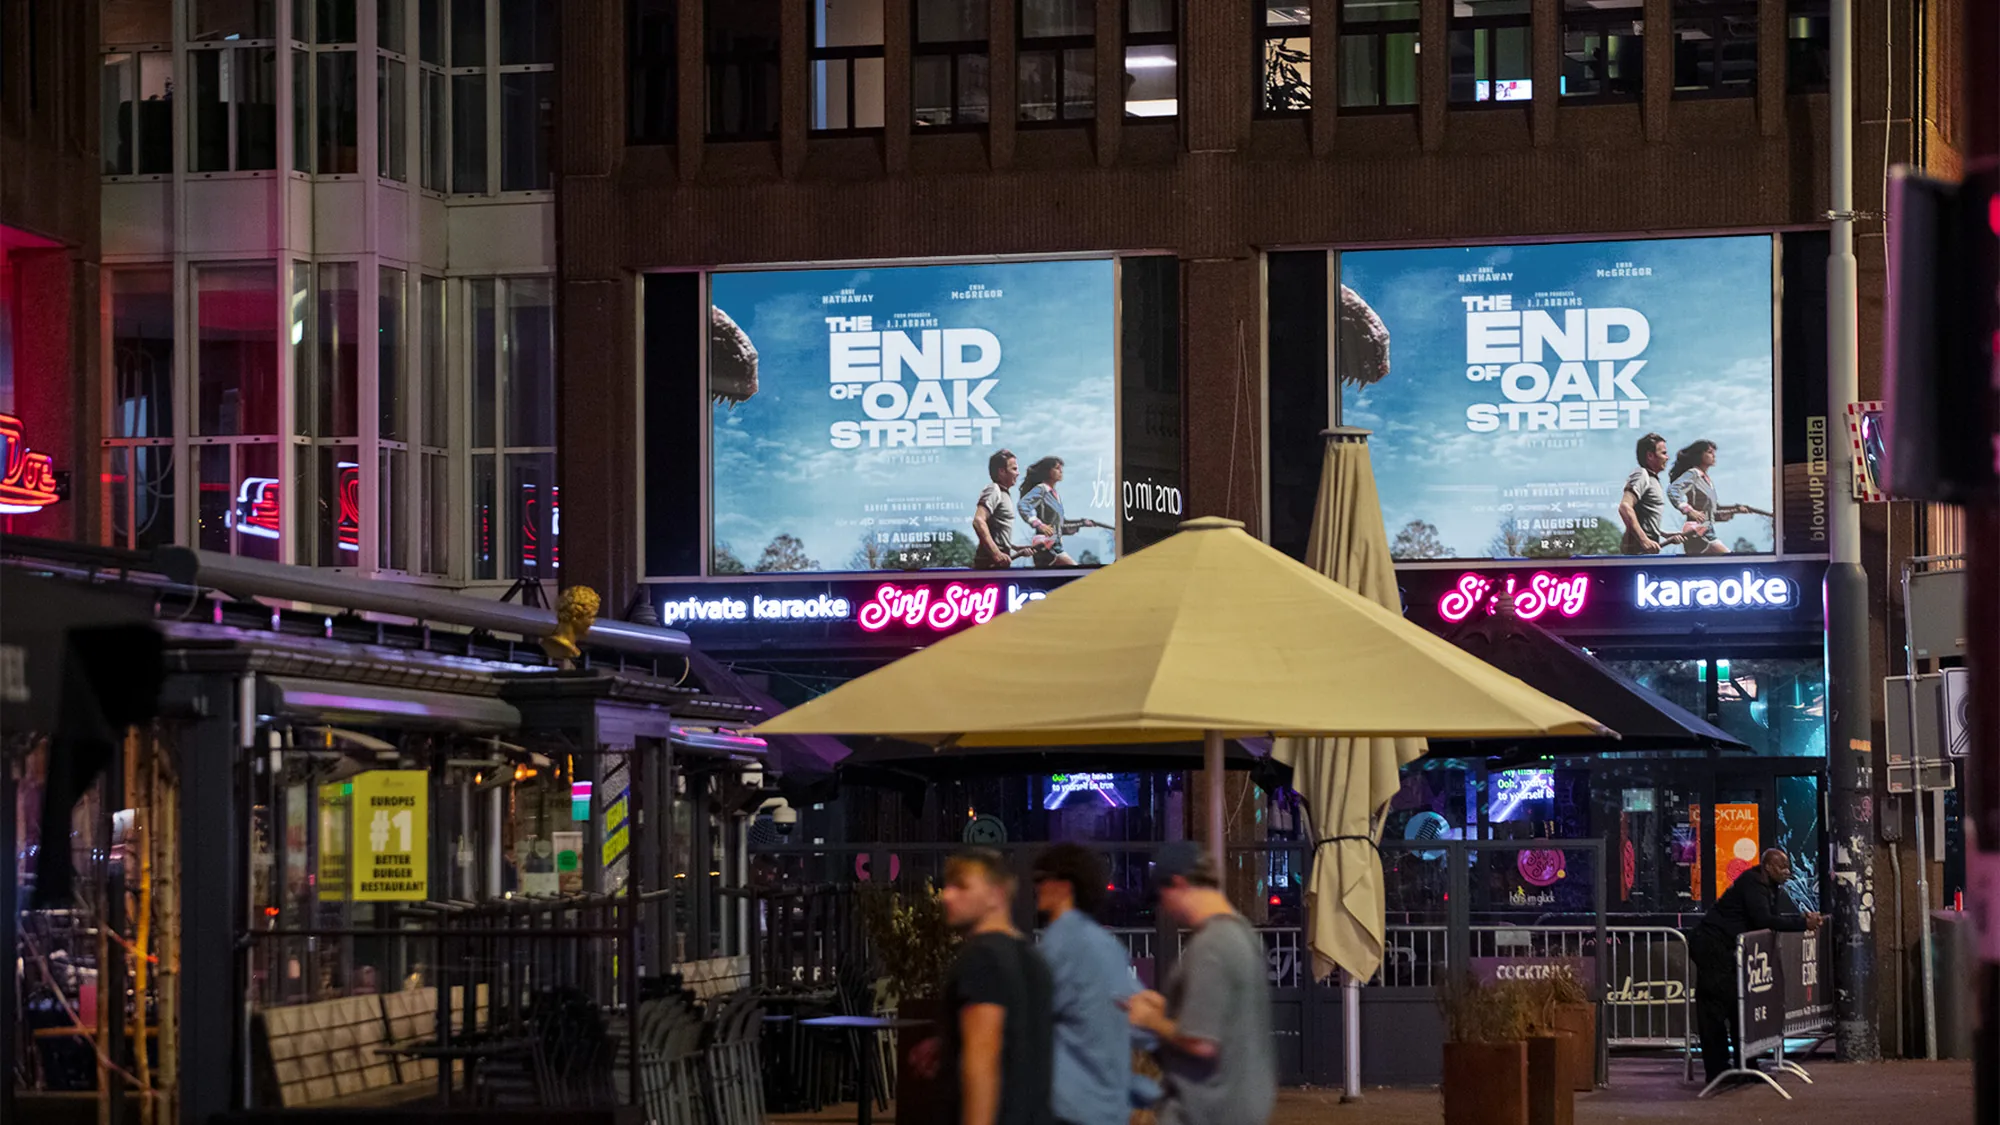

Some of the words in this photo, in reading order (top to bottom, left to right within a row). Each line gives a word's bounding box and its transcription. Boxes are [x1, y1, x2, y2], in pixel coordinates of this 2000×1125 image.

[1458, 273, 1513, 282] HATHAWAY
[1596, 268, 1652, 277] McGREGOR
[822, 294, 874, 304] HATHAWAY
[951, 290, 1003, 300] McGREGOR
[1461, 295, 1512, 311] THE
[825, 316, 873, 332] THE
[1466, 308, 1651, 364] END
[829, 328, 1001, 382] END
[1466, 364, 1500, 381] OF
[1500, 360, 1648, 402] OAK
[829, 383, 863, 400] OF
[861, 379, 1000, 421] OAK
[1466, 400, 1650, 432] STREET
[829, 418, 1001, 449] STREET
[1809, 418, 1824, 473] media
[1809, 477, 1825, 542] blowUP
[1516, 519, 1530, 530] 13
[1533, 517, 1599, 529] AUGUSTUS
[877, 533, 889, 543] 13
[892, 531, 954, 543] AUGUSTUS
[664, 596, 747, 625] private
[753, 593, 849, 619] karaoke
[859, 584, 931, 630] Sing
[927, 584, 999, 629] Sing
[1513, 573, 1590, 621] Sing
[1636, 571, 1789, 608] karaoke
[369, 810, 412, 852] #1
[375, 855, 411, 865] BETTER
[373, 868, 412, 878] BURGER
[361, 881, 424, 892] RESTAURANT
